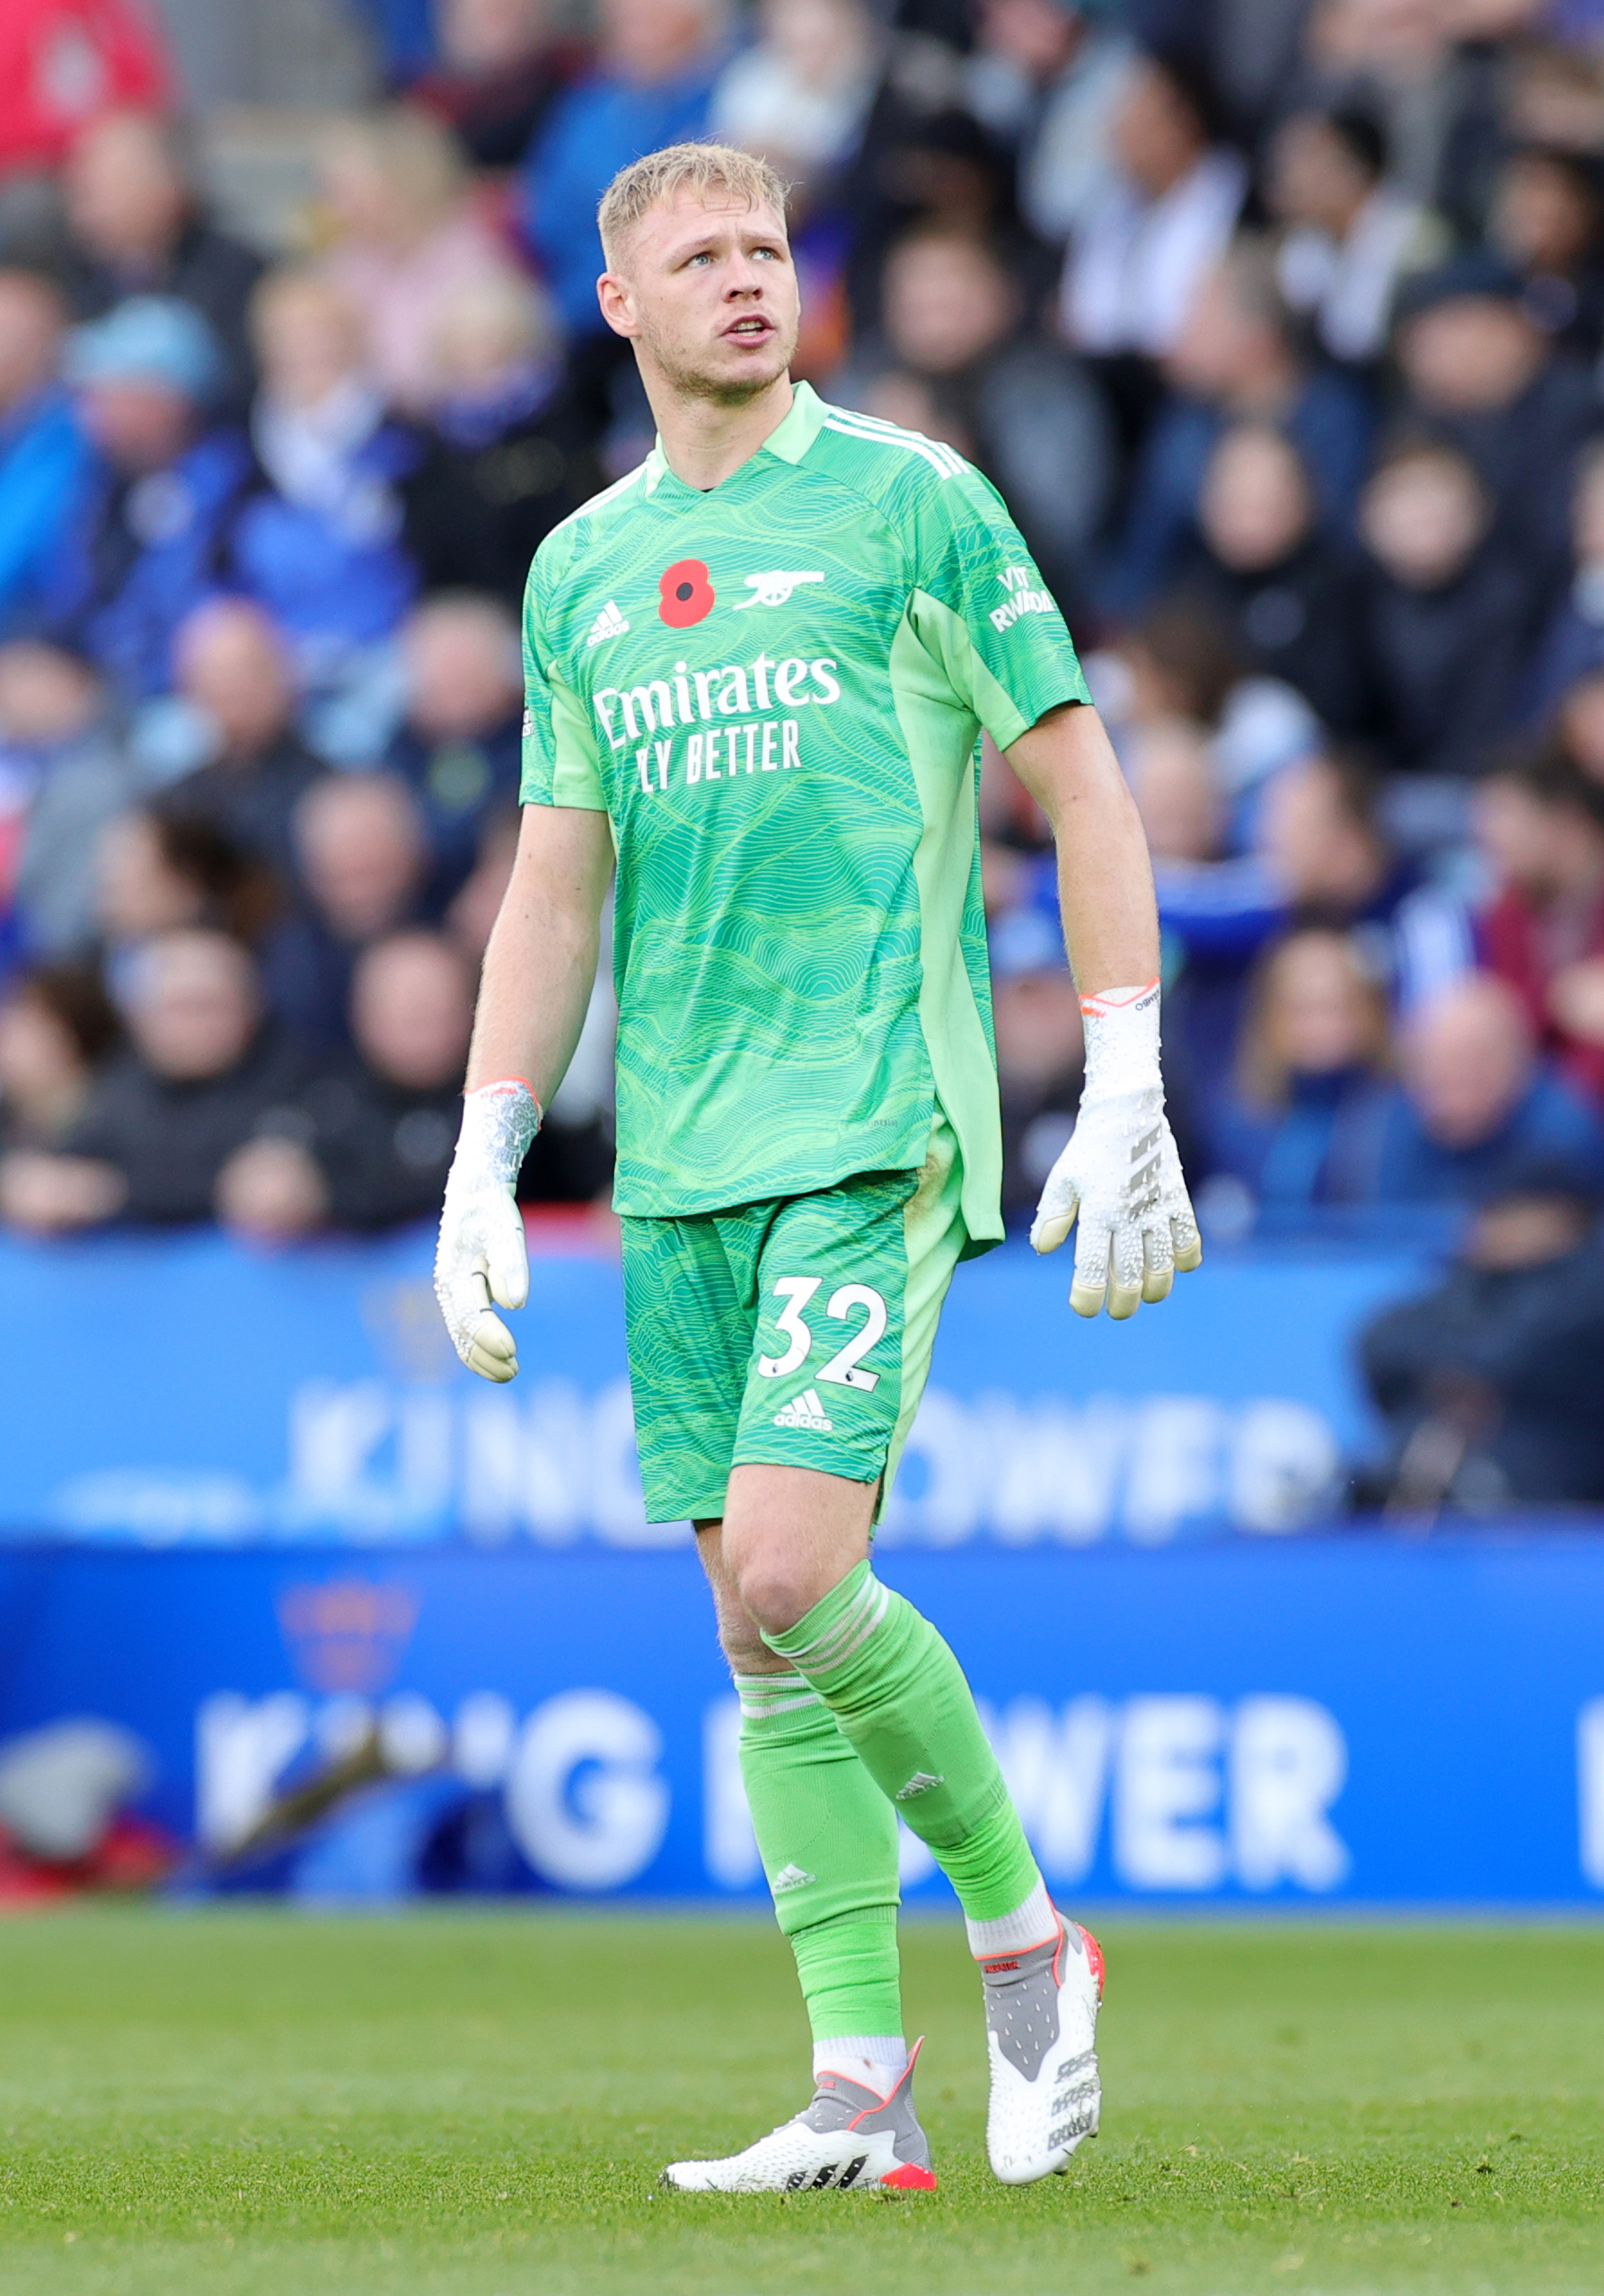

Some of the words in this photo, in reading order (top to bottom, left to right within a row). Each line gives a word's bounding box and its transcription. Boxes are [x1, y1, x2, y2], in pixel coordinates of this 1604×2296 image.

[586, 620, 630, 647] adidas
[592, 651, 841, 751] Emirates
[686, 718, 802, 785] BETTER
[757, 1276, 889, 1394] 32
[773, 1412, 834, 1431] adidas
